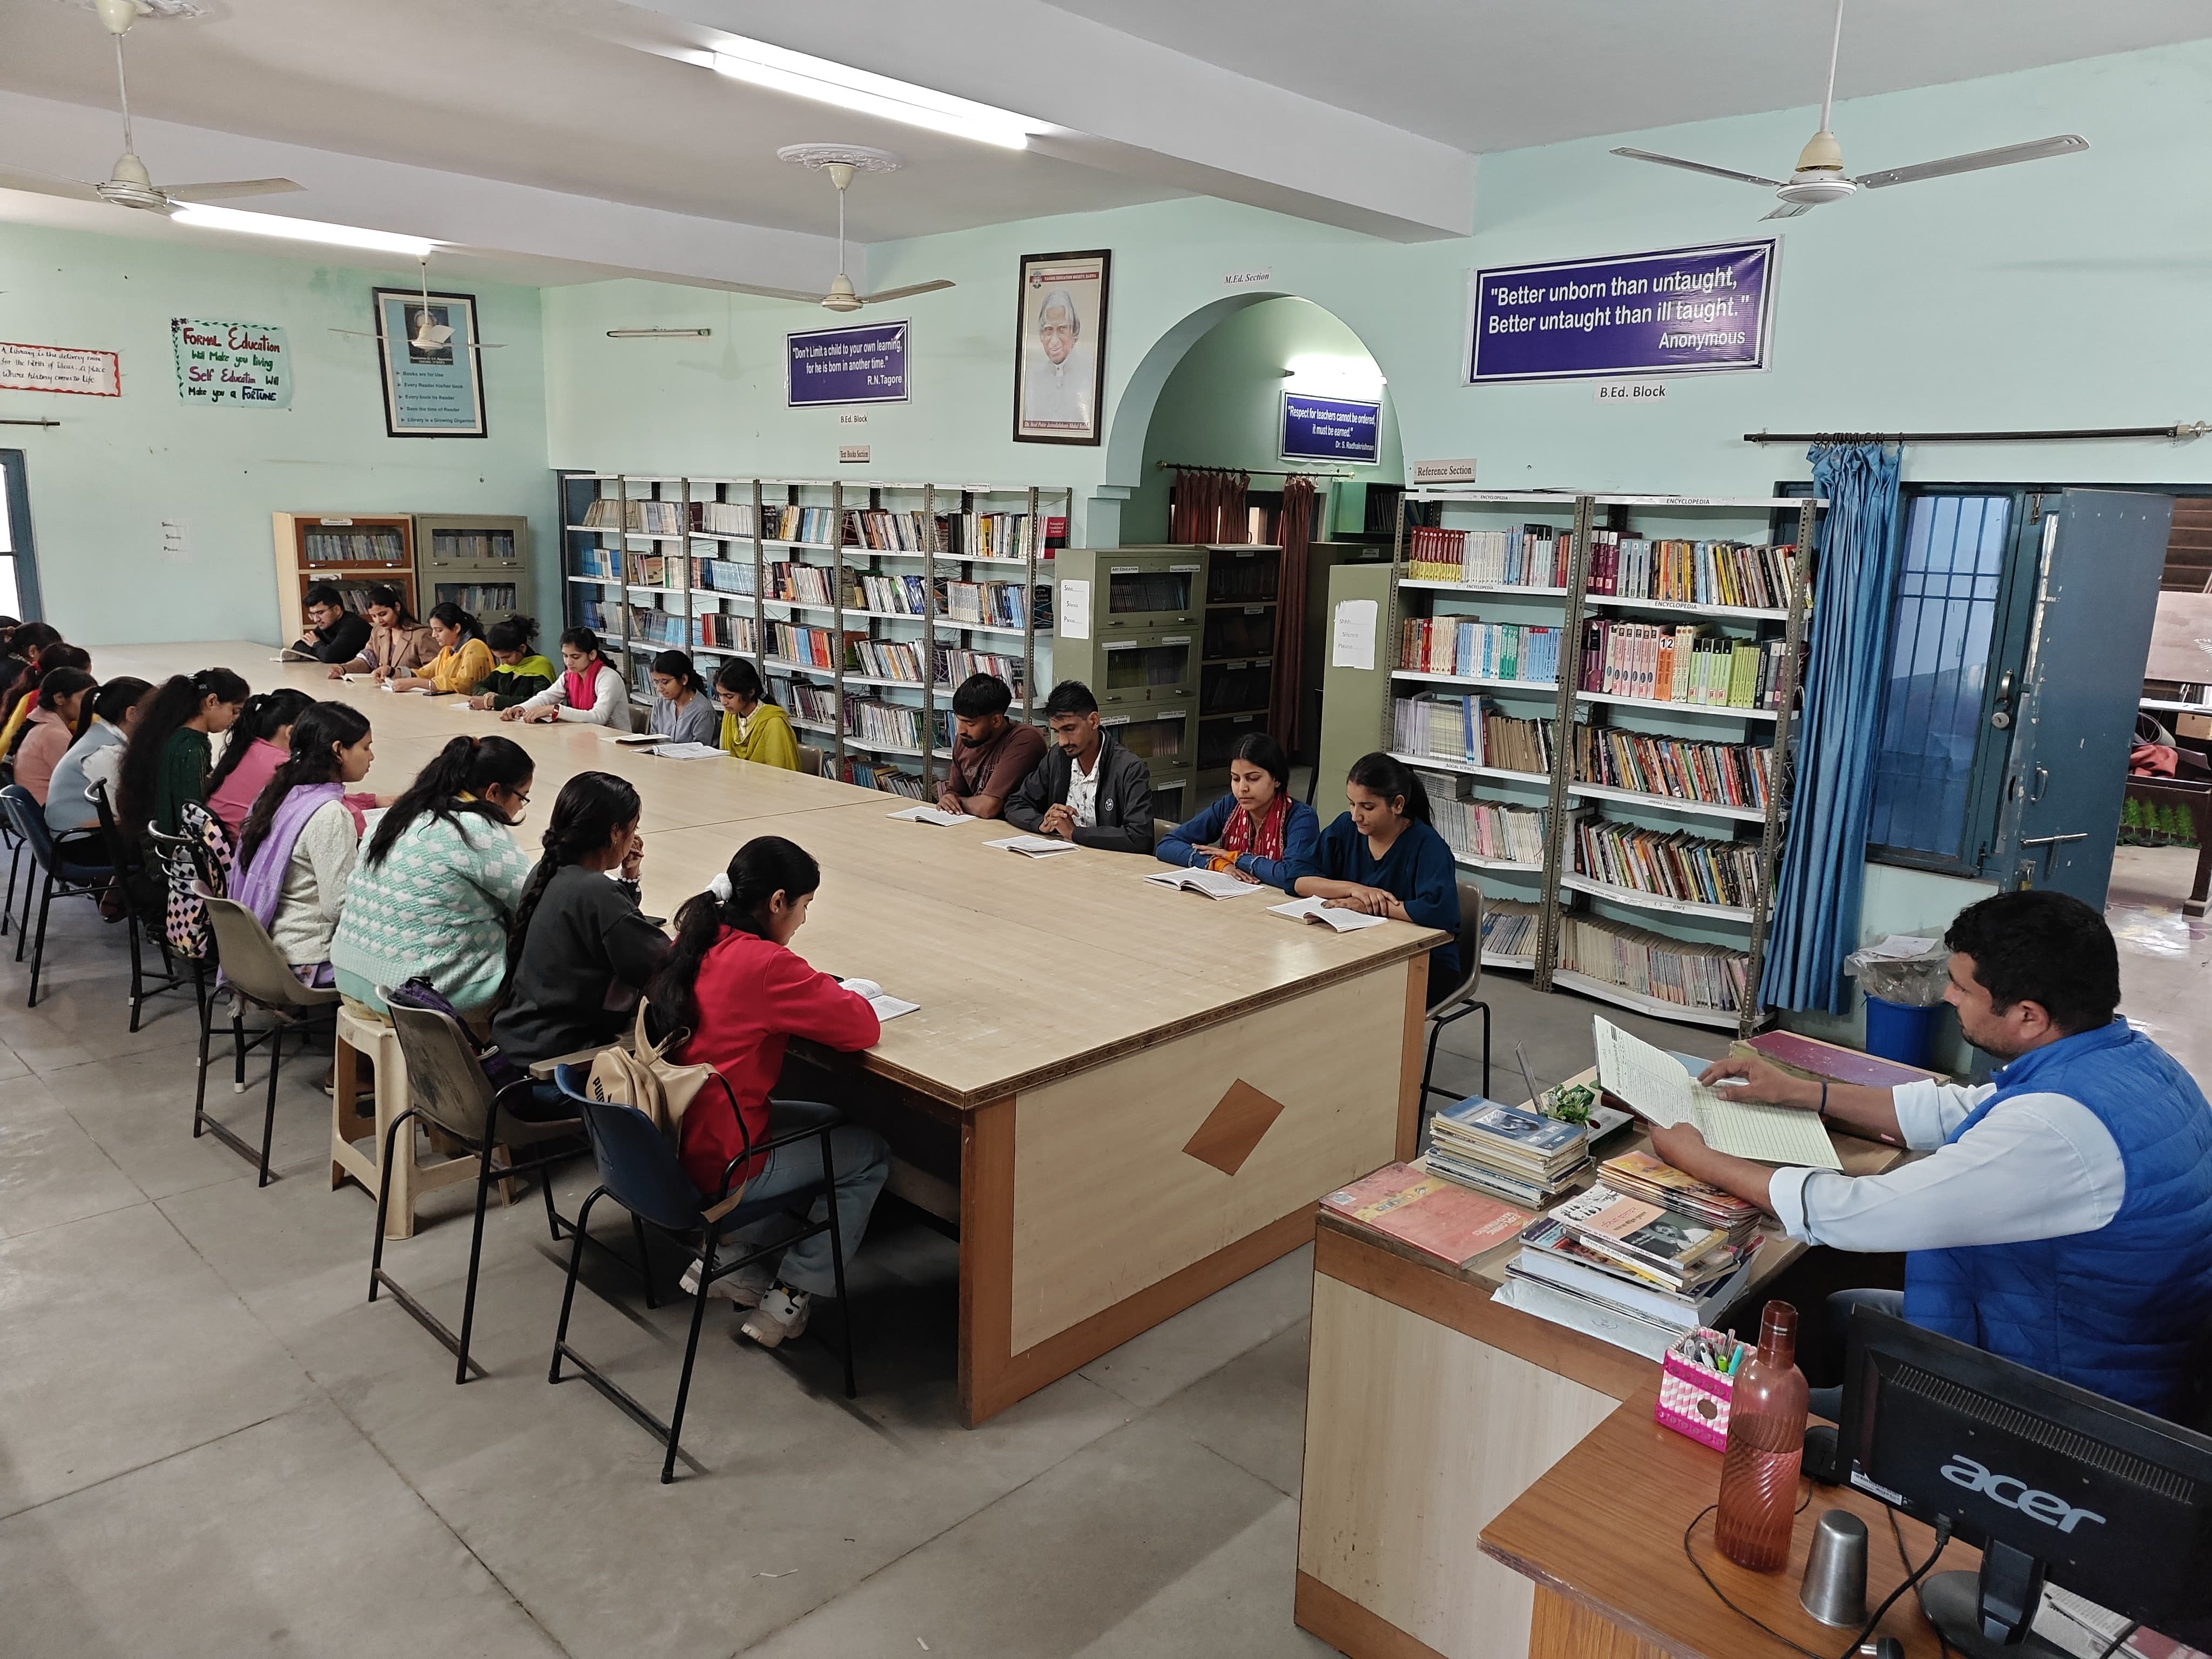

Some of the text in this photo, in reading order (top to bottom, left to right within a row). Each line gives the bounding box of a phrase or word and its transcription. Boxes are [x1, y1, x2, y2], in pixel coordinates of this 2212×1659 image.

[1224, 272, 1270, 284] M.Ed. Section
[1491, 266, 1737, 307] "Better unborn than untaught,
[1488, 313, 1536, 334] Better
[1540, 306, 1610, 333] untaught
[1615, 305, 1651, 325] than
[1657, 301, 1671, 321] ill
[183, 327, 280, 353] FORMAL Education
[1658, 332, 1745, 350] Anonymous
[792, 338, 902, 359] "Don't Limit a child to your own learning,
[59, 353, 85, 363] delivery
[192, 350, 273, 372] Will Make you living
[815, 362, 821, 373] he
[822, 361, 827, 373] is
[828, 360, 841, 373] born
[842, 359, 848, 372] in
[849, 358, 871, 371] another
[871, 355, 888, 369] time."
[48, 361, 53, 369] of
[88, 366, 105, 374] place
[28, 372, 53, 383] history
[188, 366, 214, 382] Self
[220, 368, 256, 384] Education
[867, 375, 902, 386] R.N.Tagore
[188, 387, 207, 396] Make
[212, 390, 225, 402] you
[230, 390, 237, 399] a
[1599, 385, 1666, 399] B.Ed. Block
[854, 414, 867, 422] Block
[1288, 405, 1309, 420] "Respect
[1317, 409, 1336, 421] teachers
[1337, 412, 1351, 422] cannot
[1352, 413, 1357, 423] be
[1358, 414, 1375, 427] ordered,
[1312, 424, 1353, 437] it must be earned."
[1346, 442, 1374, 450] Radhakrishnan
[1417, 464, 1472, 477] Reference Section
[1654, 601, 1698, 610] ENCYCLOPEDIA
[1661, 638, 1665, 648] 1
[1667, 639, 1673, 649] 2
[593, 1076, 605, 1102] PUM
[1941, 1454, 2106, 1533] acer
